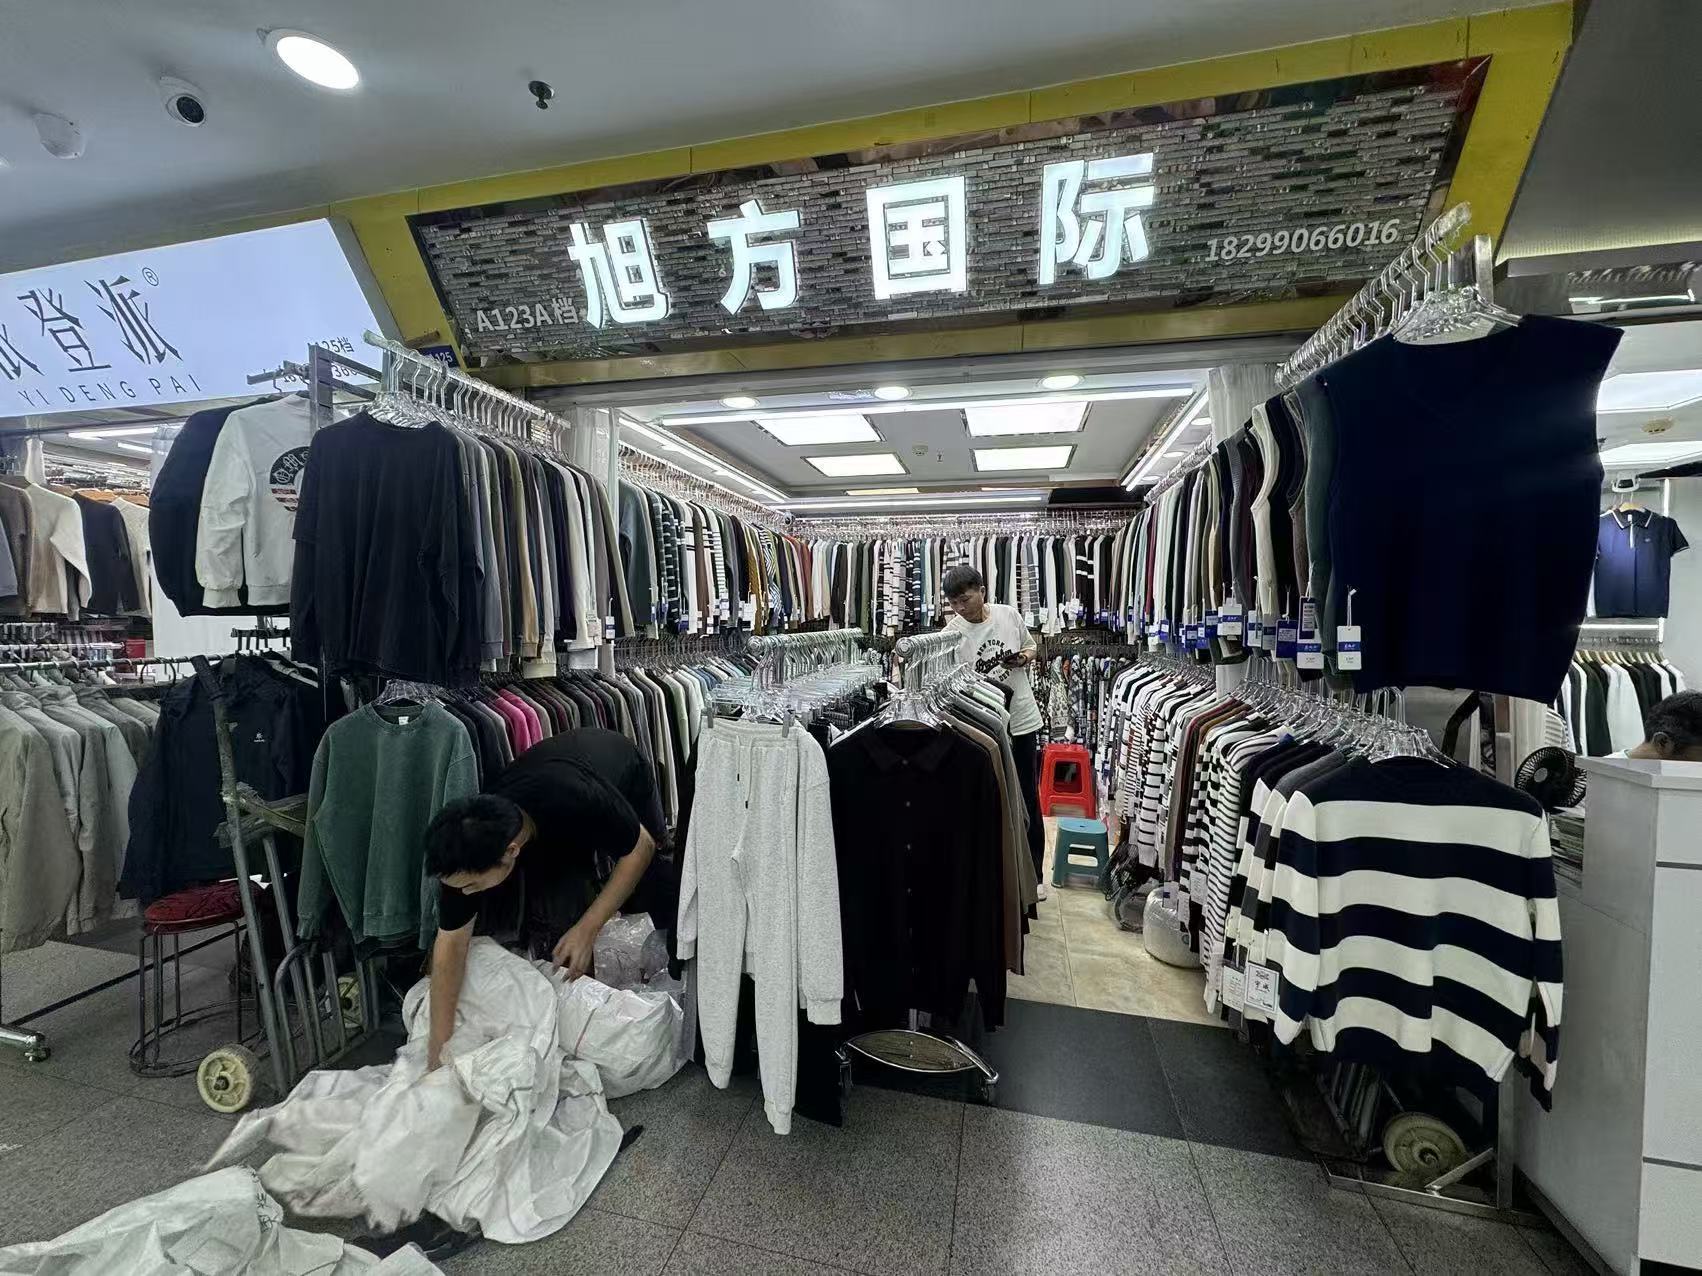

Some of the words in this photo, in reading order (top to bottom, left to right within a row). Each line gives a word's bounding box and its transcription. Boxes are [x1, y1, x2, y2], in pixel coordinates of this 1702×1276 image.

[566, 152, 1155, 328] 旭方国际
[1205, 218, 1400, 262] 18299066016
[476, 297, 579, 332] A123A档
[18, 388, 50, 407] YI
[59, 380, 137, 403] DENG
[148, 373, 201, 396] PAI
[987, 639, 1005, 649] YORK
